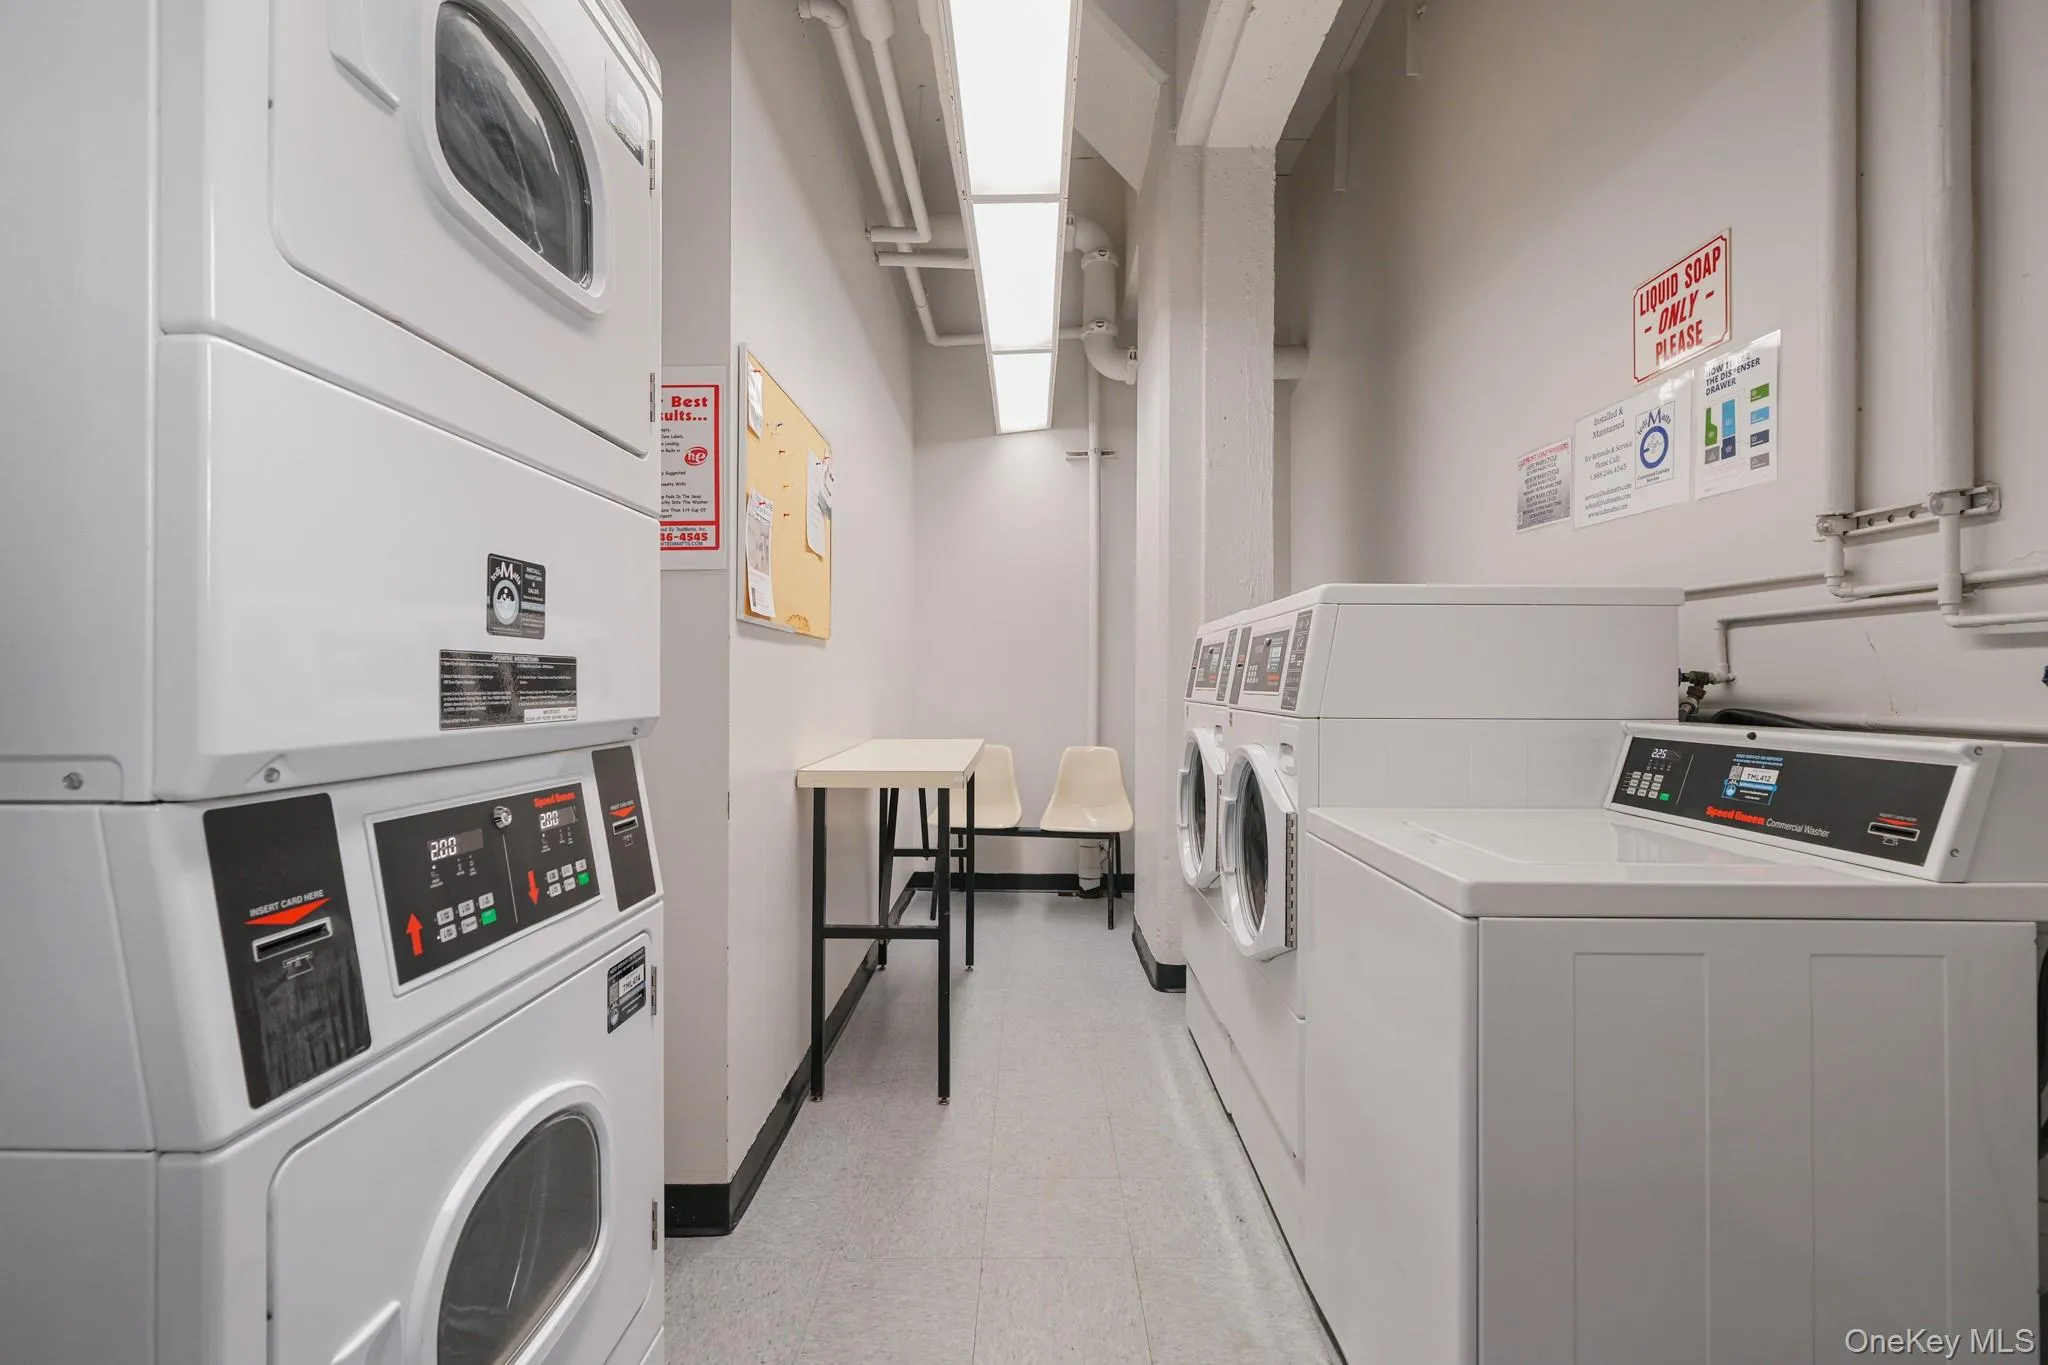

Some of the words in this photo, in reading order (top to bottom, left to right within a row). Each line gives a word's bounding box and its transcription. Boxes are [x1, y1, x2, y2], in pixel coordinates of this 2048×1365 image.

[1640, 273, 1678, 316] LIQUID
[1685, 246, 1721, 288] SOAP
[1658, 289, 1699, 334] ONLY
[1656, 320, 1702, 365] PLEASE
[1706, 375, 1719, 386] THE
[1706, 378, 1736, 396] DRAWER
[661, 410, 707, 421] ults...
[672, 396, 708, 407] Best
[1706, 805, 1735, 819] Speed
[1735, 811, 1766, 826] Queen
[1766, 818, 1803, 832] Commercial
[1804, 824, 1830, 838] Washer
[249, 901, 280, 917] INSERT
[281, 896, 303, 908] CARD
[304, 889, 325, 901] HERE
